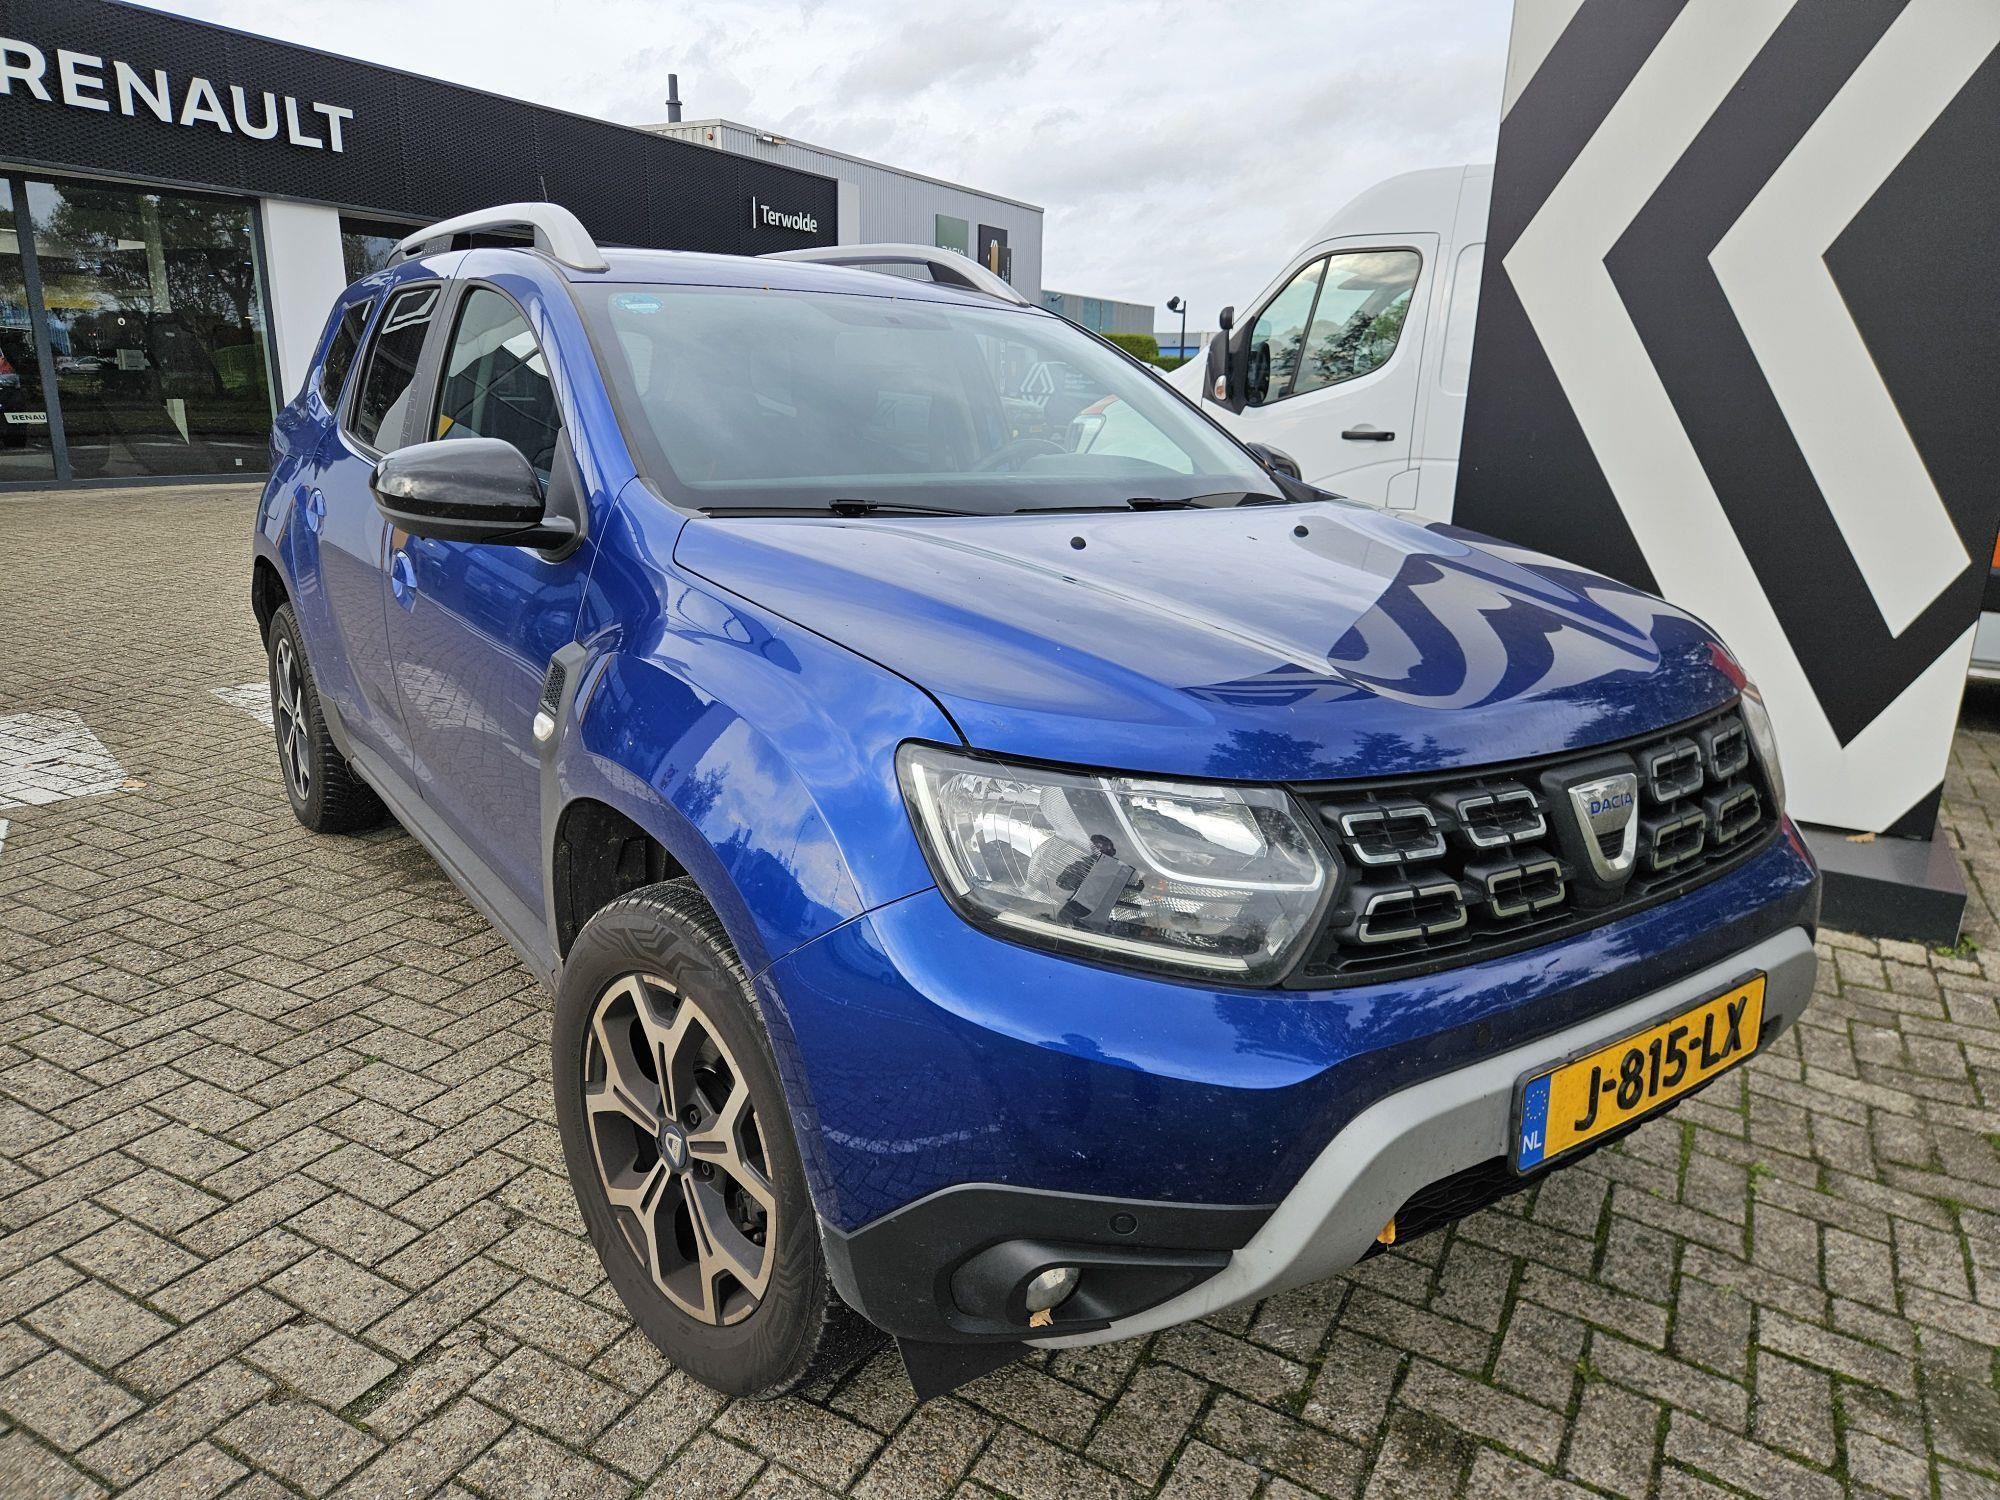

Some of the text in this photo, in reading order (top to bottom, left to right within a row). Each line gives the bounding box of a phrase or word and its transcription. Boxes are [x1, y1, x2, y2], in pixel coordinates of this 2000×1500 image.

[0, 37, 353, 152] RENAULT
[760, 204, 818, 233] Terwolde
[1590, 793, 1633, 814] DACIA
[1574, 996, 1748, 1131] J-815-LX
[1522, 1131, 1542, 1154] NL
